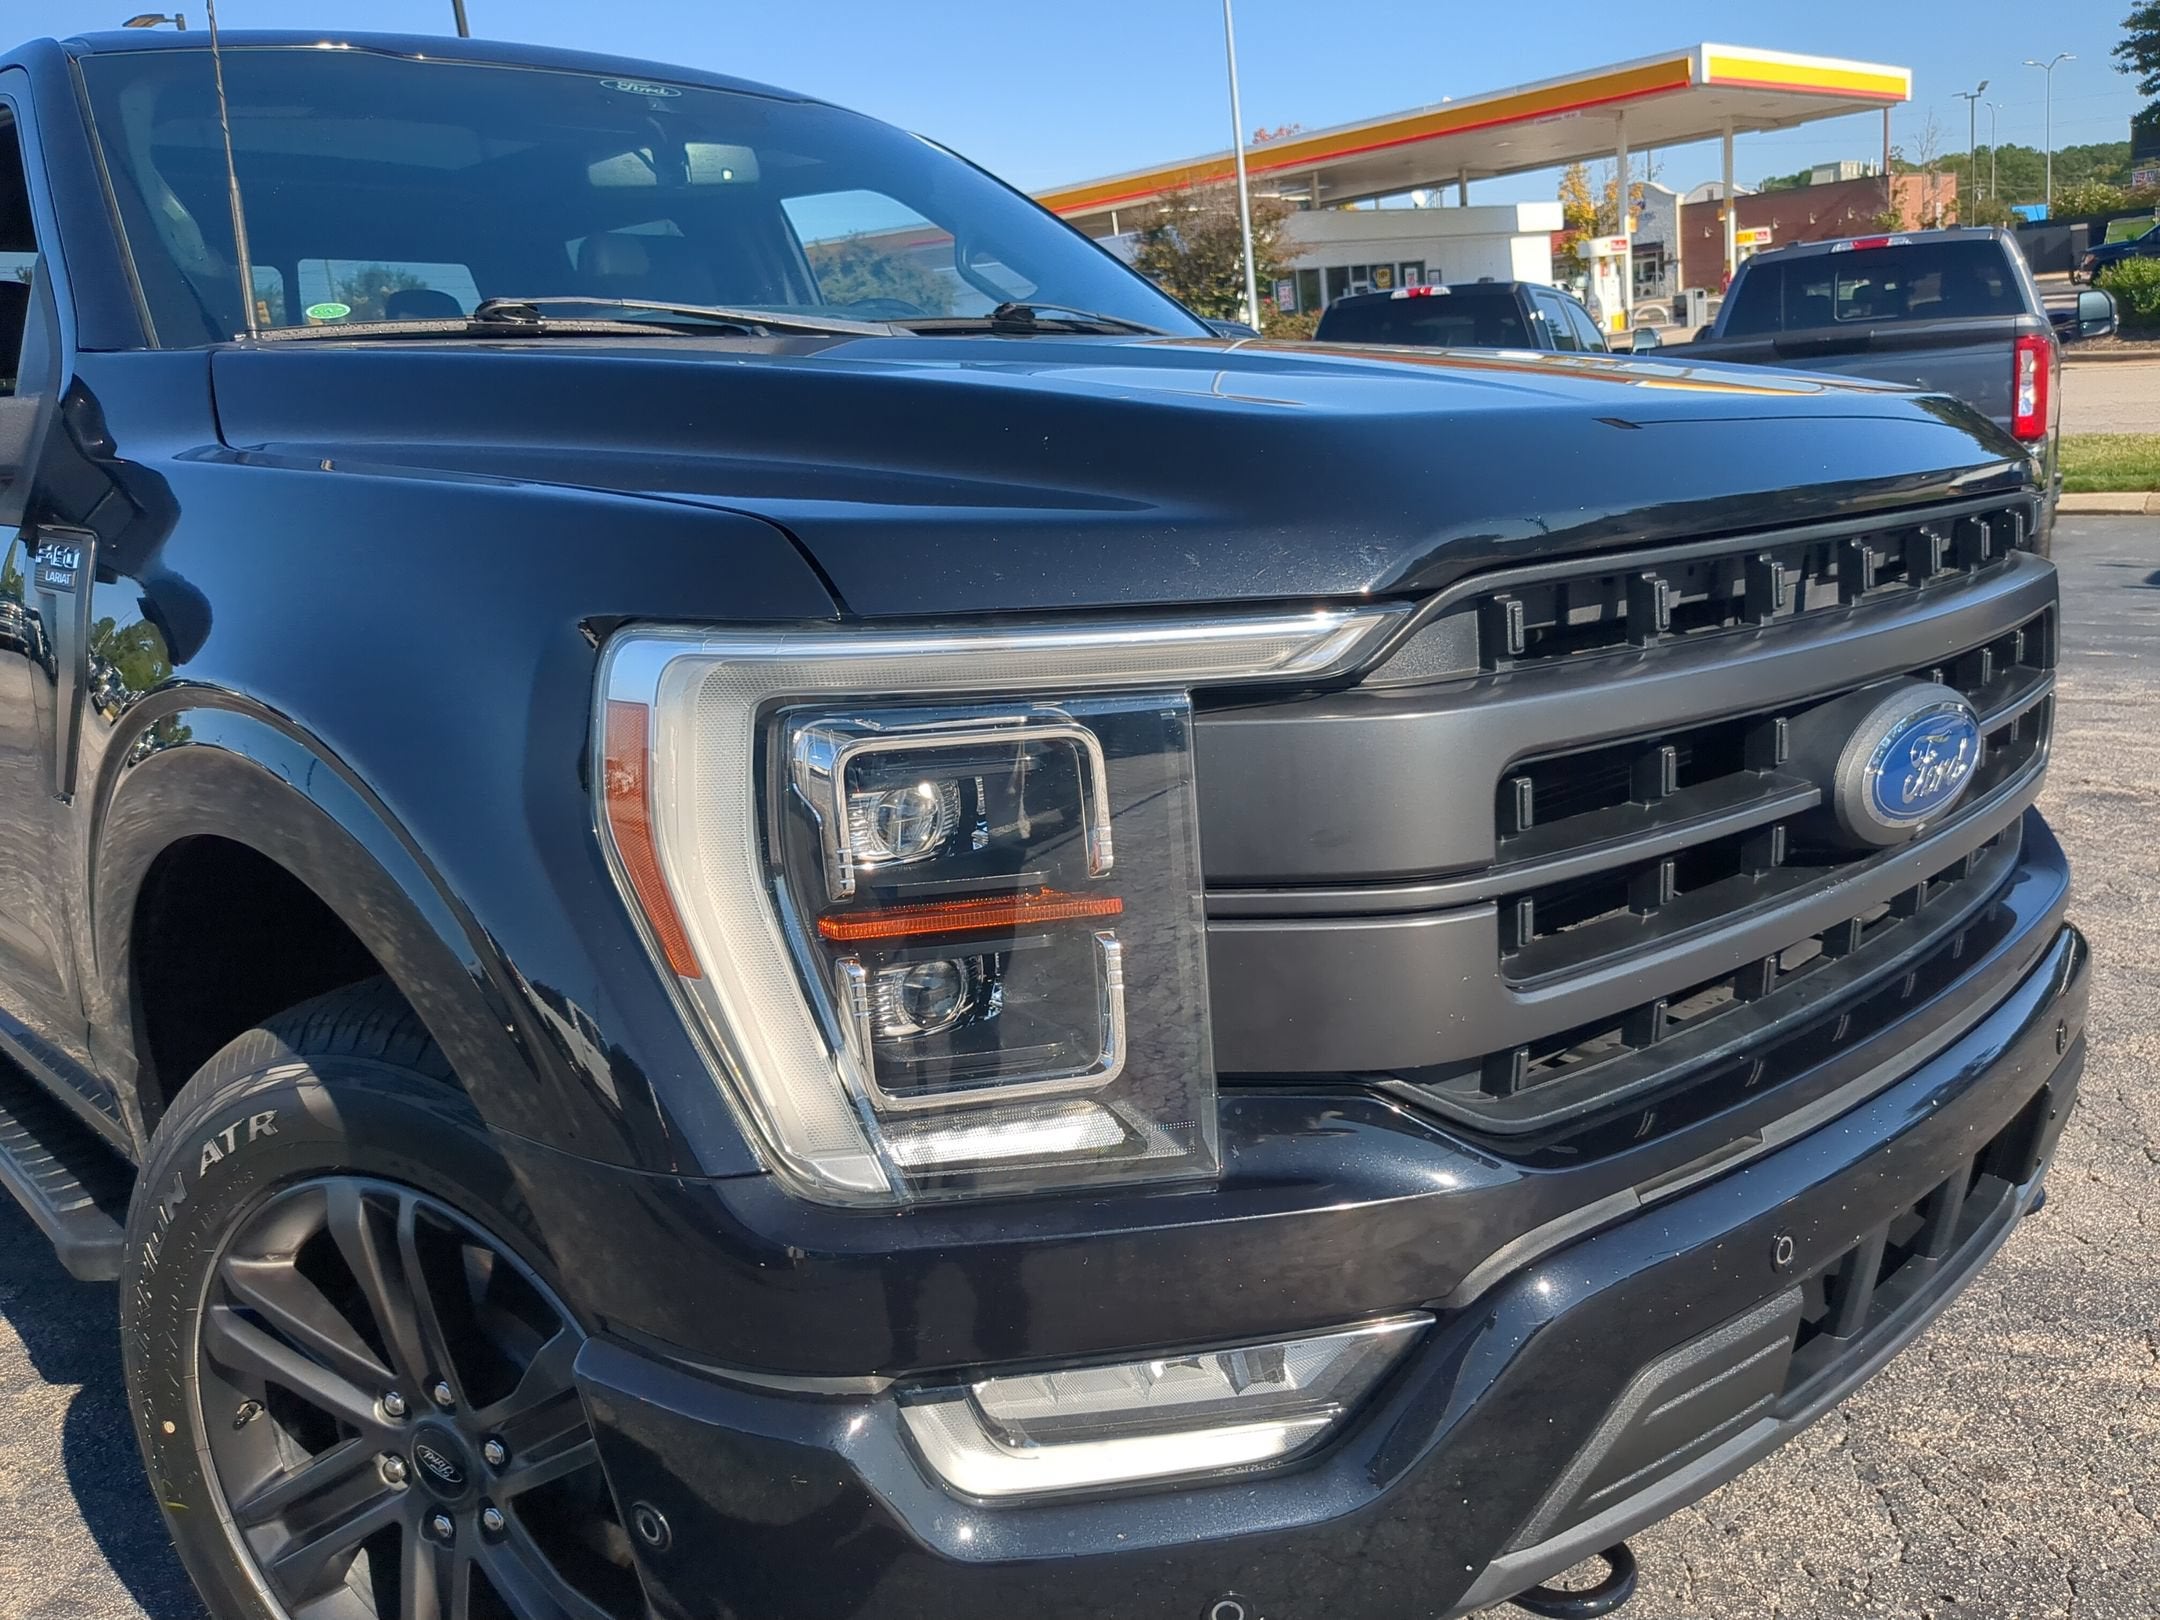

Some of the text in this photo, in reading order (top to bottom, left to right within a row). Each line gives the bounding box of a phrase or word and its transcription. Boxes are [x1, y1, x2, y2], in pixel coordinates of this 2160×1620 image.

[616, 80, 669, 96] Ford
[45, 570, 73, 585] LARIAT
[1902, 729, 1967, 804] Ford
[200, 1109, 279, 1178] ATR
[423, 1450, 455, 1478] Ford
